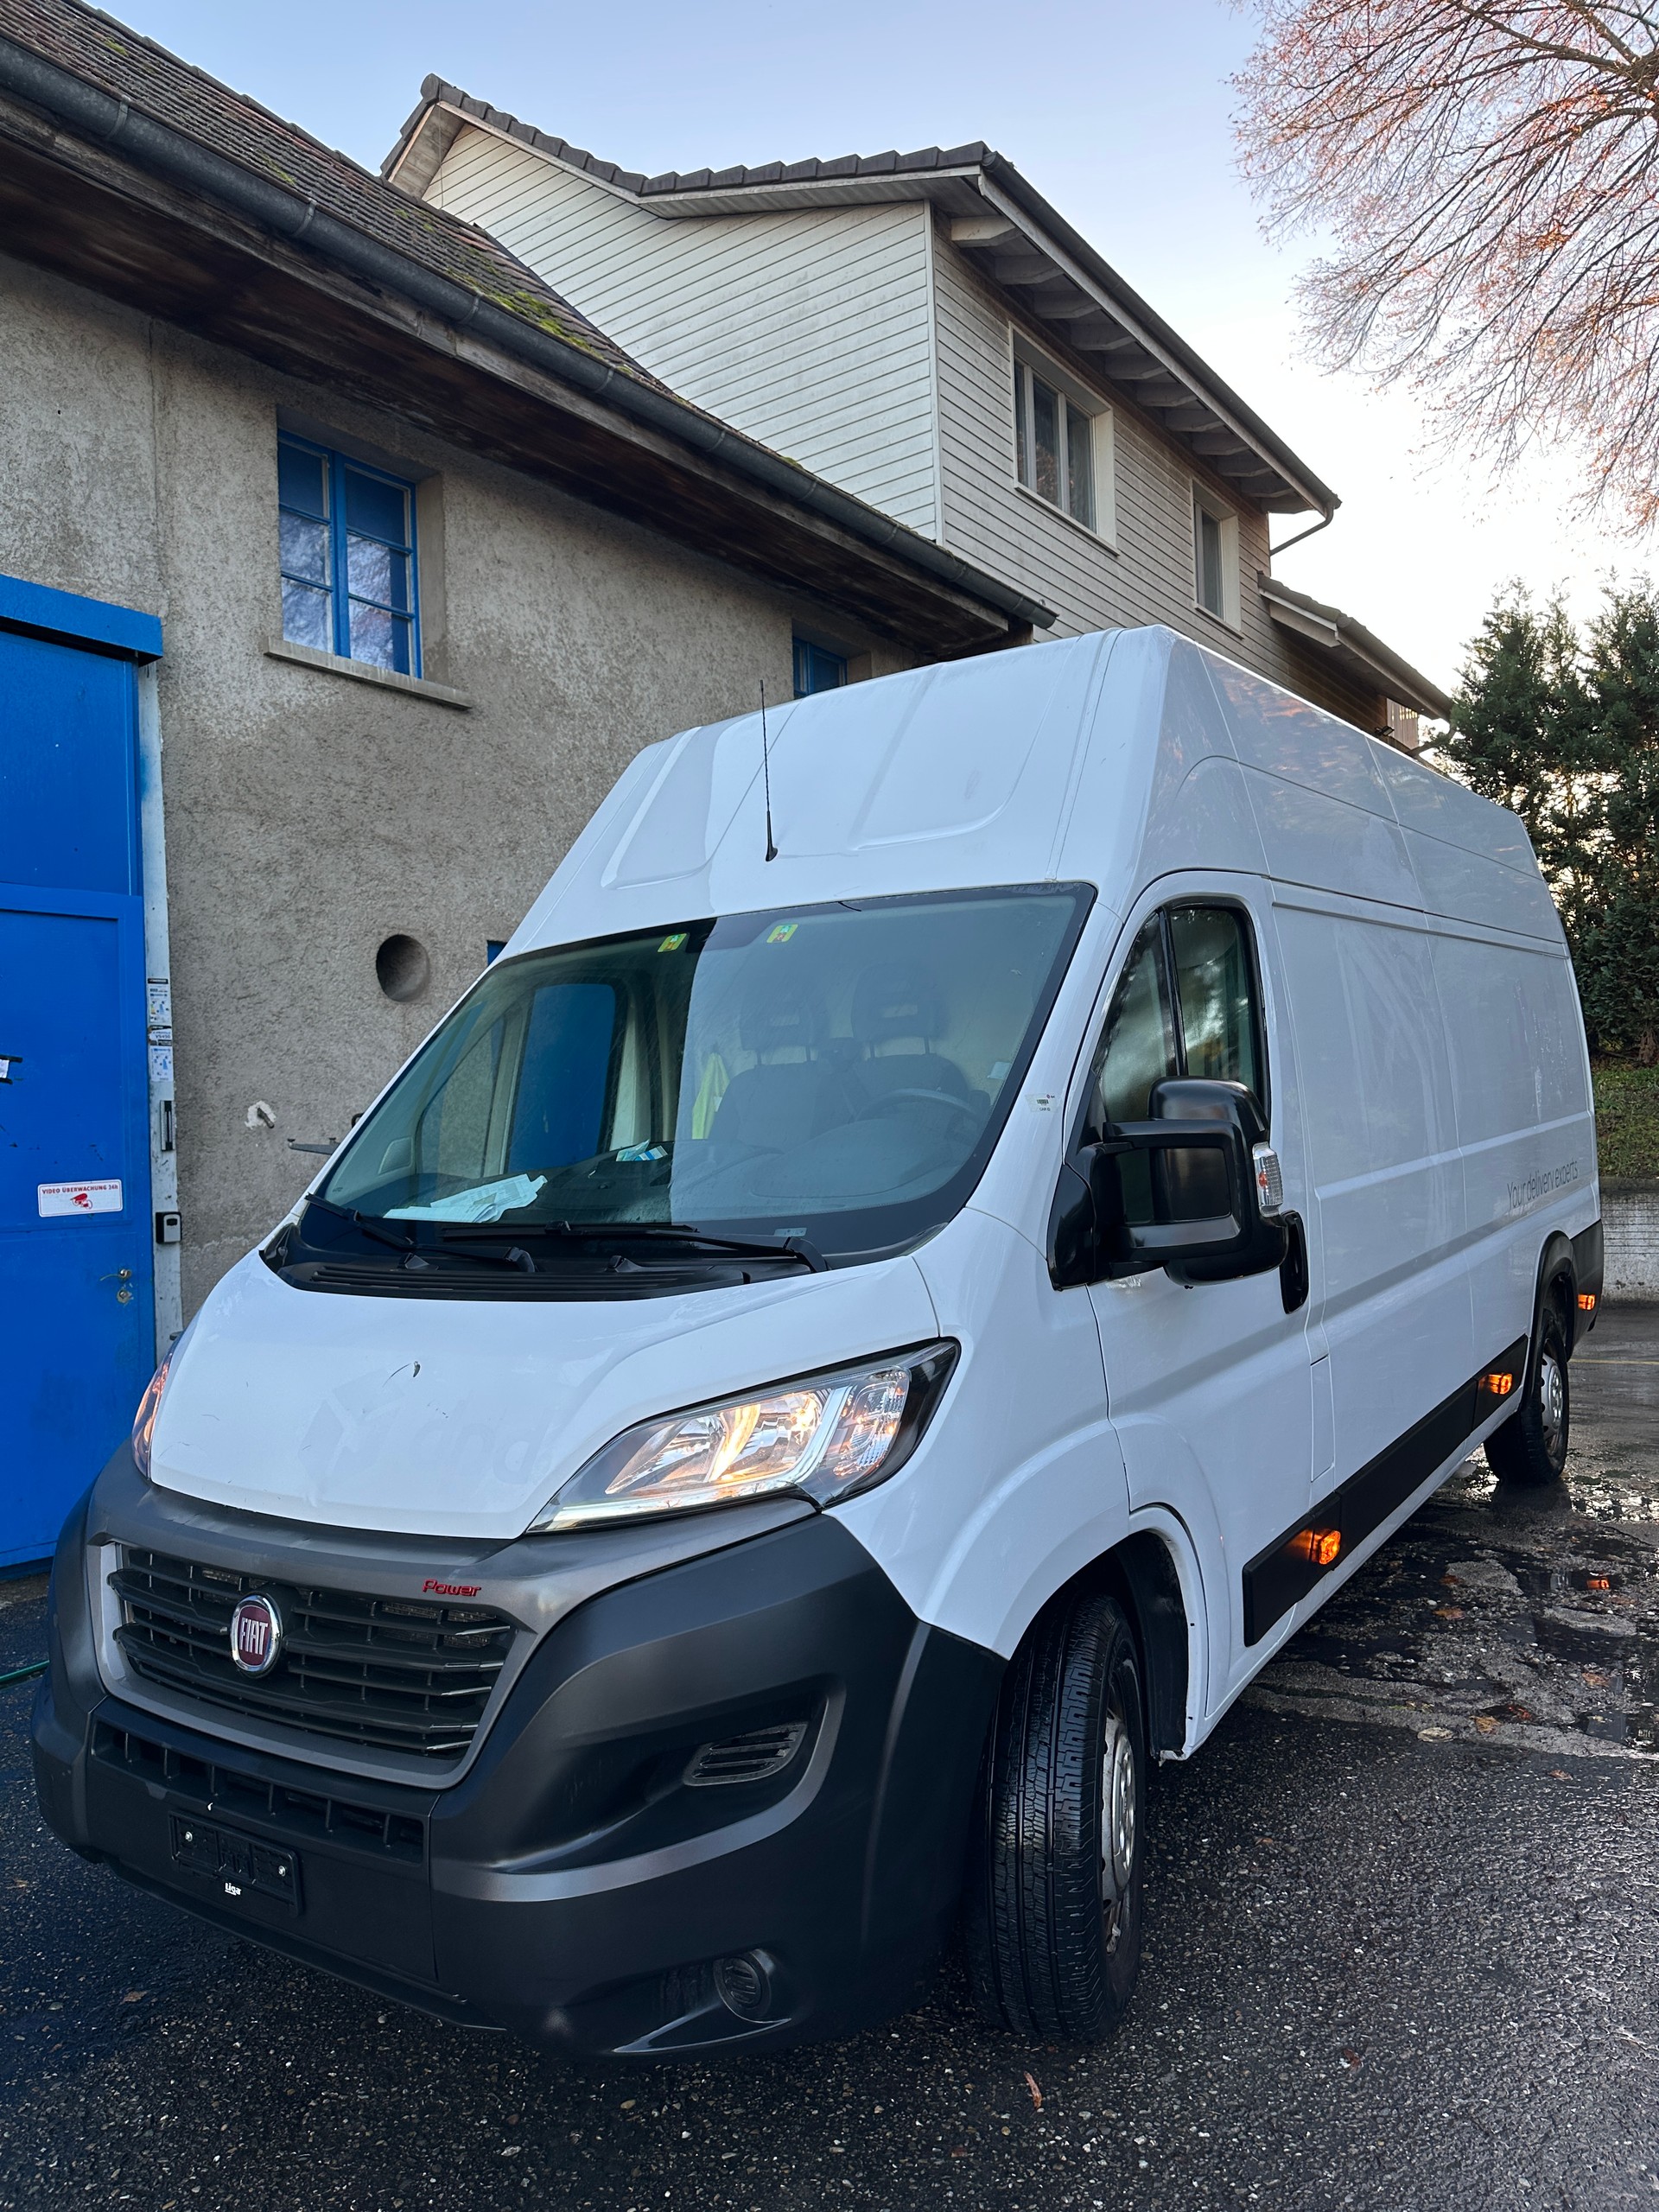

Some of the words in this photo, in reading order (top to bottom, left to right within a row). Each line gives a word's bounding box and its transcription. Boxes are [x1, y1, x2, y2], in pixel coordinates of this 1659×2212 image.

[61, 1185, 107, 1193] ÜBERWACHUNG
[1507, 1182, 1526, 1210] Your
[1527, 1169, 1554, 1201] delivery
[1555, 1159, 1579, 1189] experts
[423, 1579, 482, 1597] Power
[238, 1616, 269, 1655] FIAT
